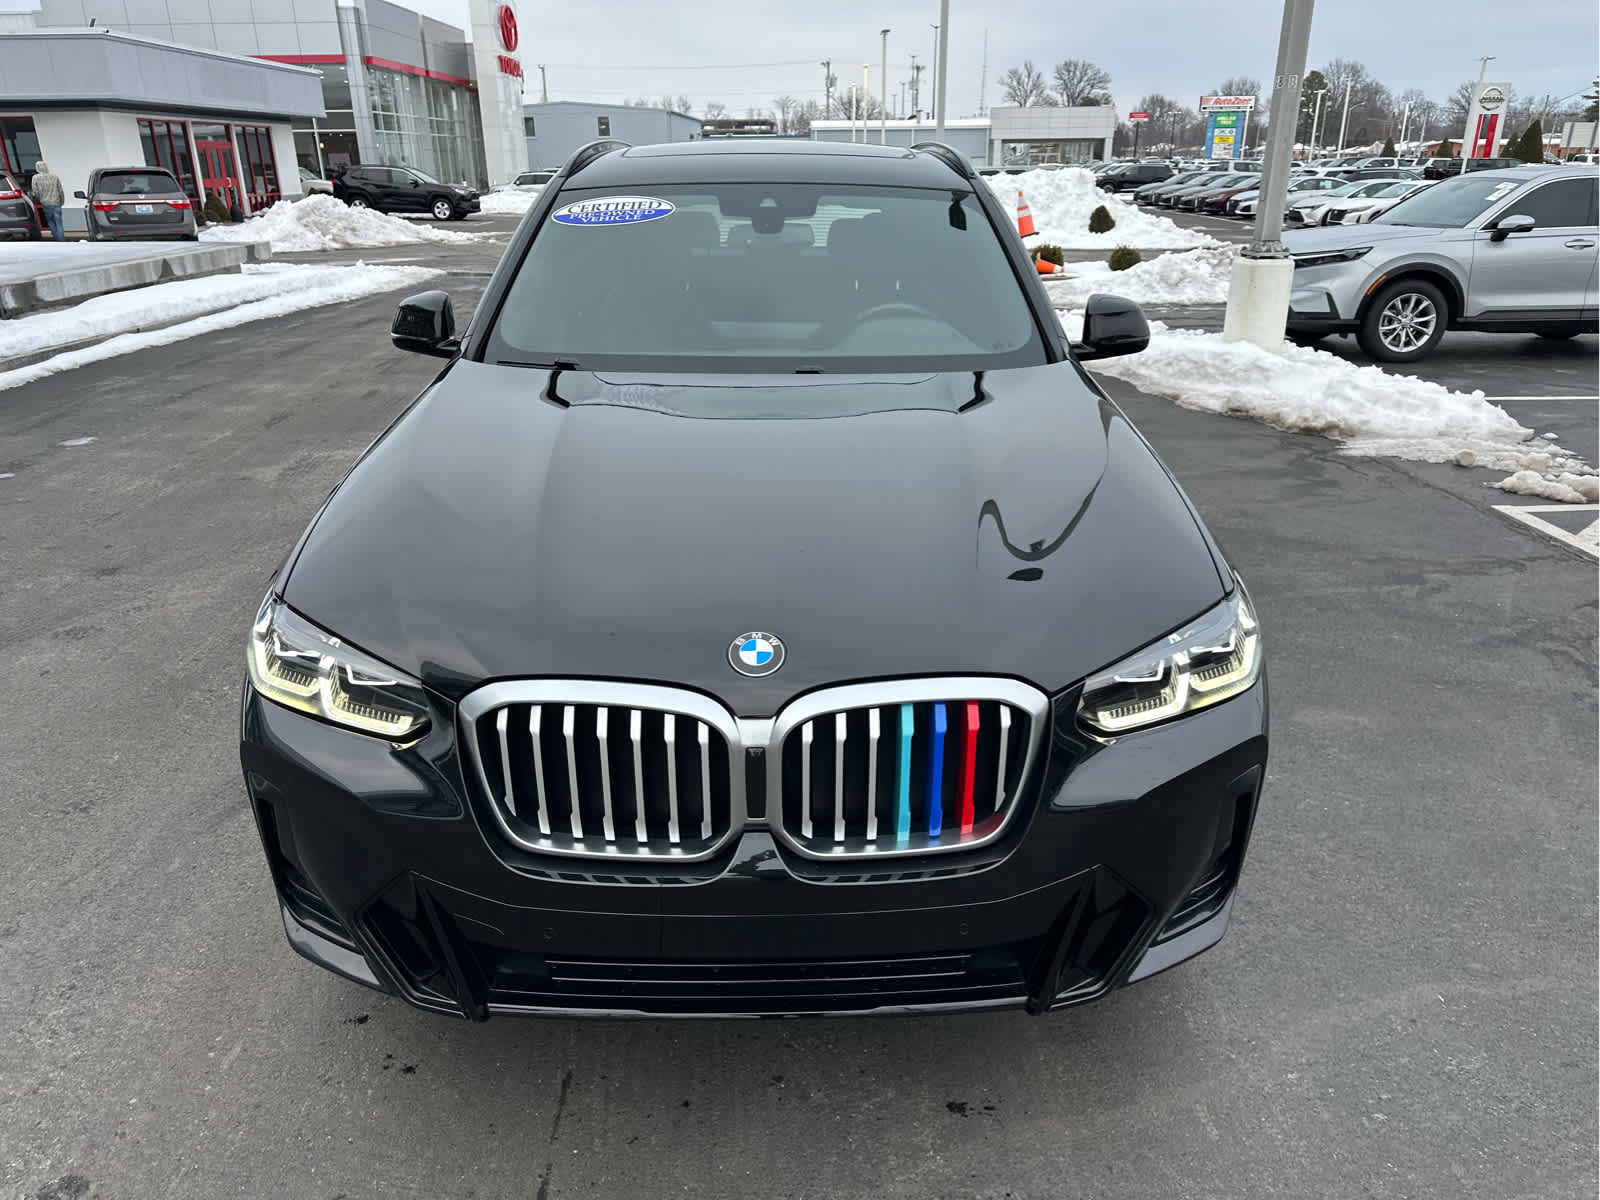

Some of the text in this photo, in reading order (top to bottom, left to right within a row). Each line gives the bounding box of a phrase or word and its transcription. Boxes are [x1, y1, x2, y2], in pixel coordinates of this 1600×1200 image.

[498, 55, 521, 78] TOYO
[568, 201, 662, 214] CERTIFIED
[570, 209, 656, 220] PRE-OWNED
[582, 215, 641, 223] VEHICLE
[735, 633, 781, 646] BMW
